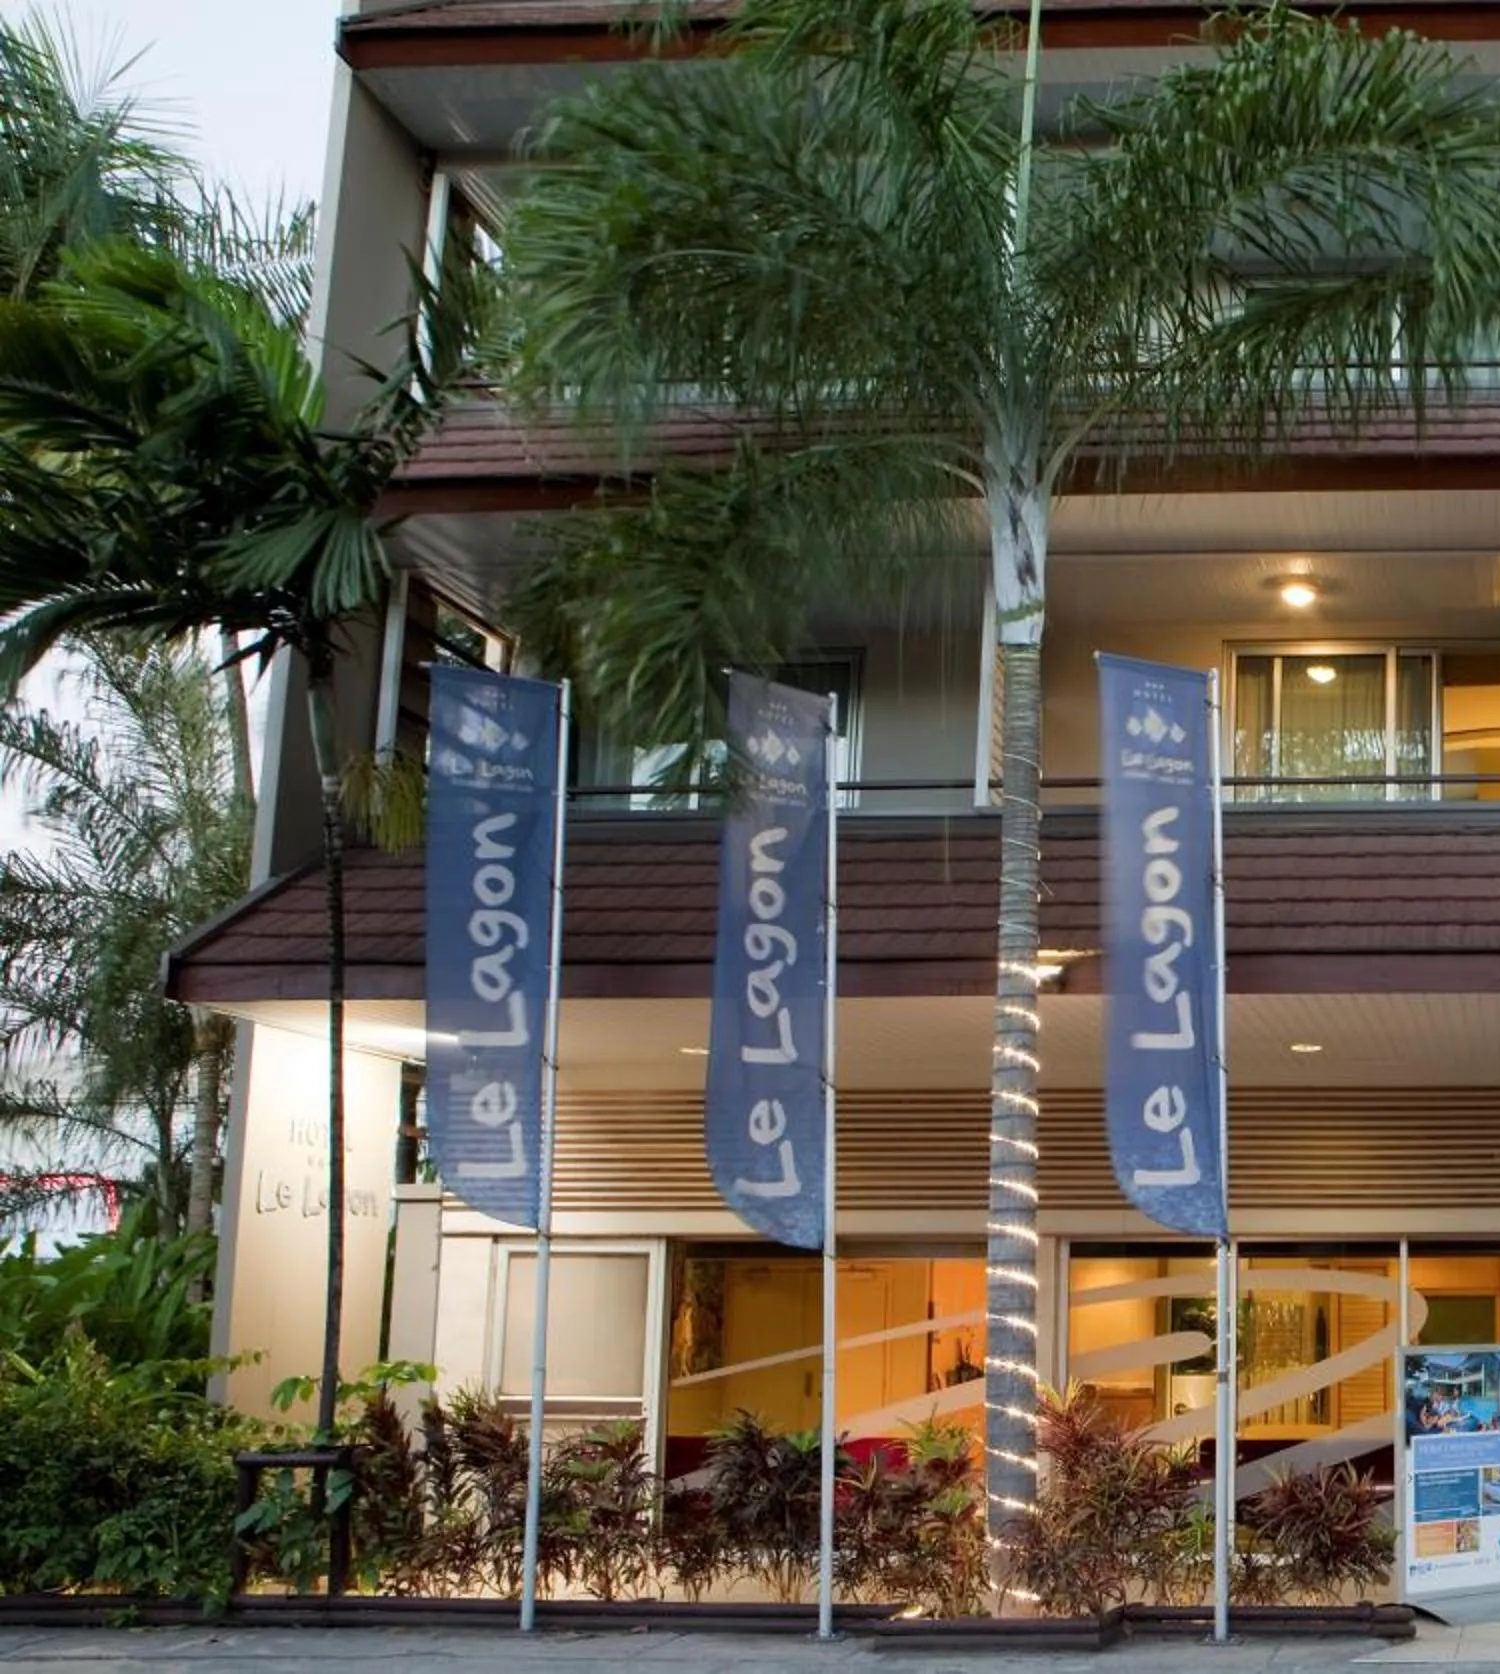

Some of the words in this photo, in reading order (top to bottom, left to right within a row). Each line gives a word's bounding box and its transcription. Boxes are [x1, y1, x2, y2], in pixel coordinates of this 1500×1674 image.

[457, 812, 530, 1047] Lagon
[739, 827, 799, 1063] Lagon
[1131, 806, 1195, 1050] Lagon
[457, 1081, 528, 1178] Le
[734, 1098, 801, 1198] Le
[1133, 1085, 1201, 1186] Le
[256, 1169, 292, 1215] Le
[301, 1174, 379, 1219] Laon
